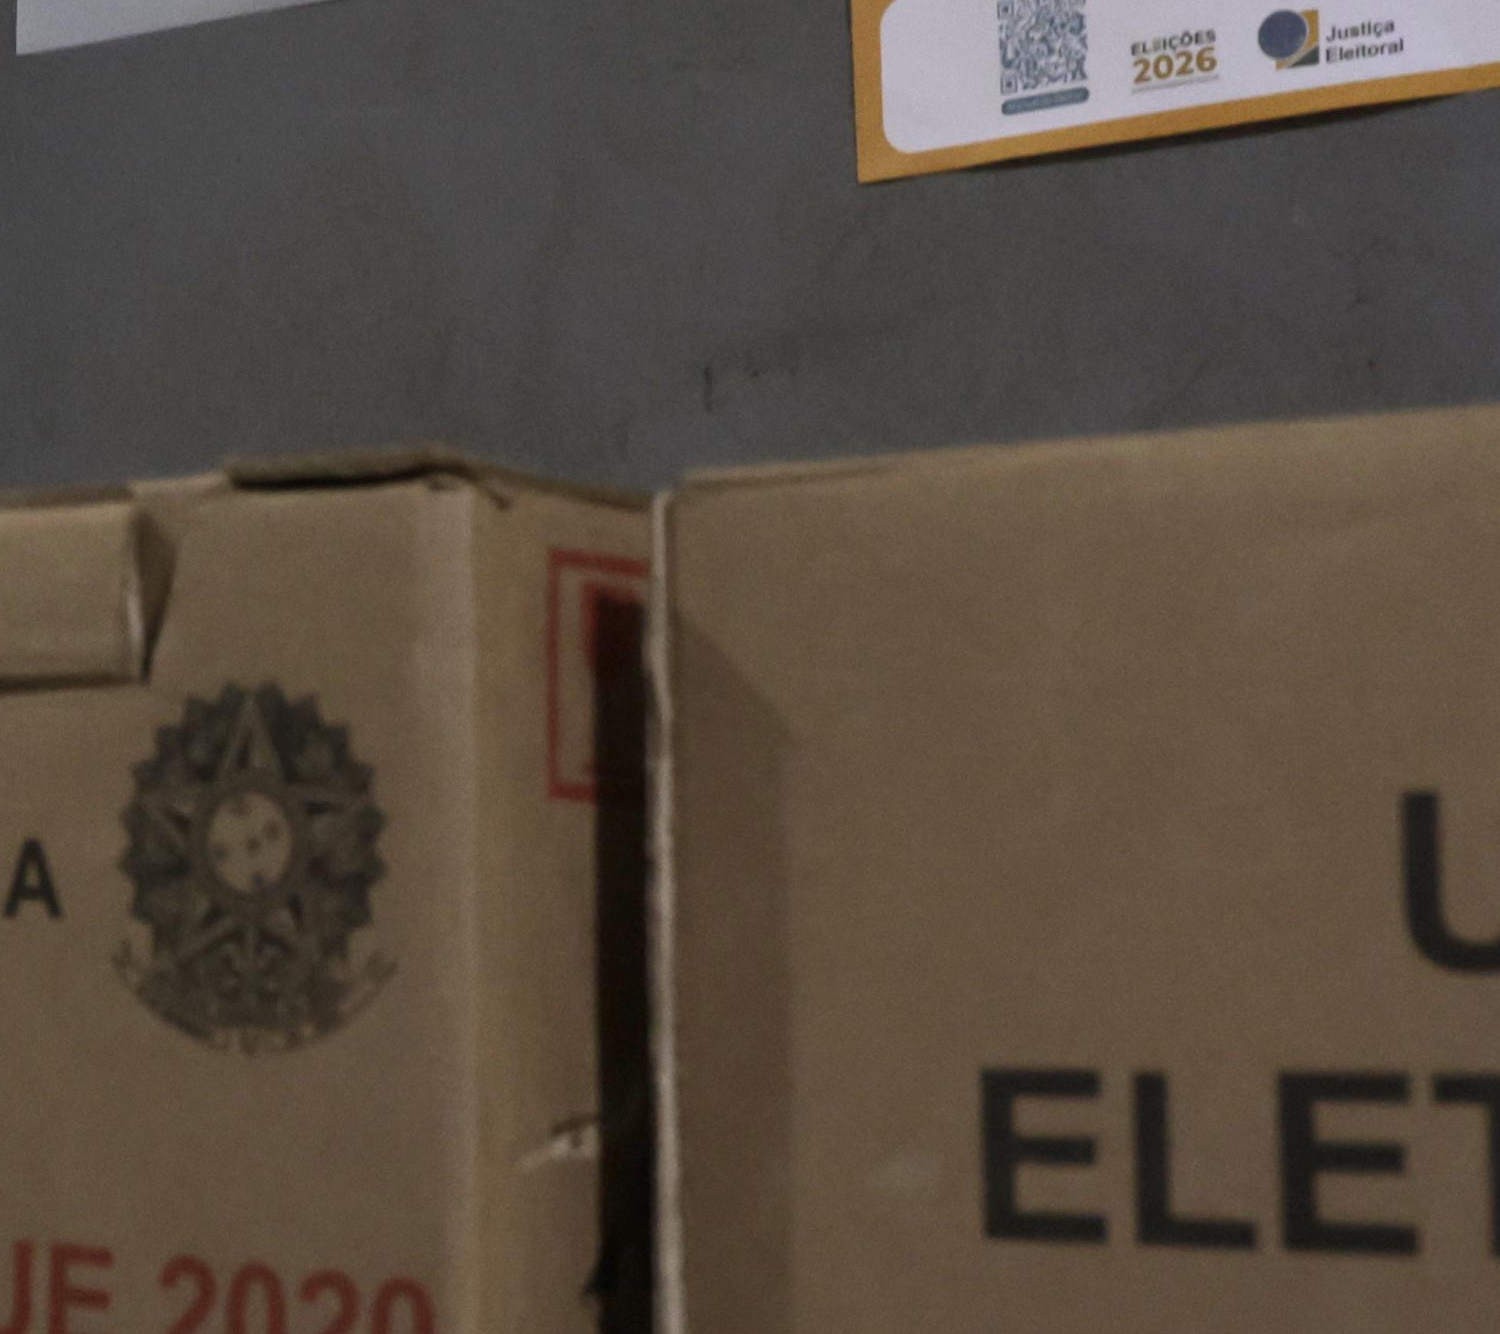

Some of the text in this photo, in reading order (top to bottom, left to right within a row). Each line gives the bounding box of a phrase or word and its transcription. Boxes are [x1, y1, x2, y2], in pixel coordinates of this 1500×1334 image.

[1129, 29, 1216, 57] ELEIÇÕES
[1325, 20, 1395, 42] Justiça
[1324, 38, 1404, 63] Eleitoral
[1133, 46, 1217, 83] 2026
